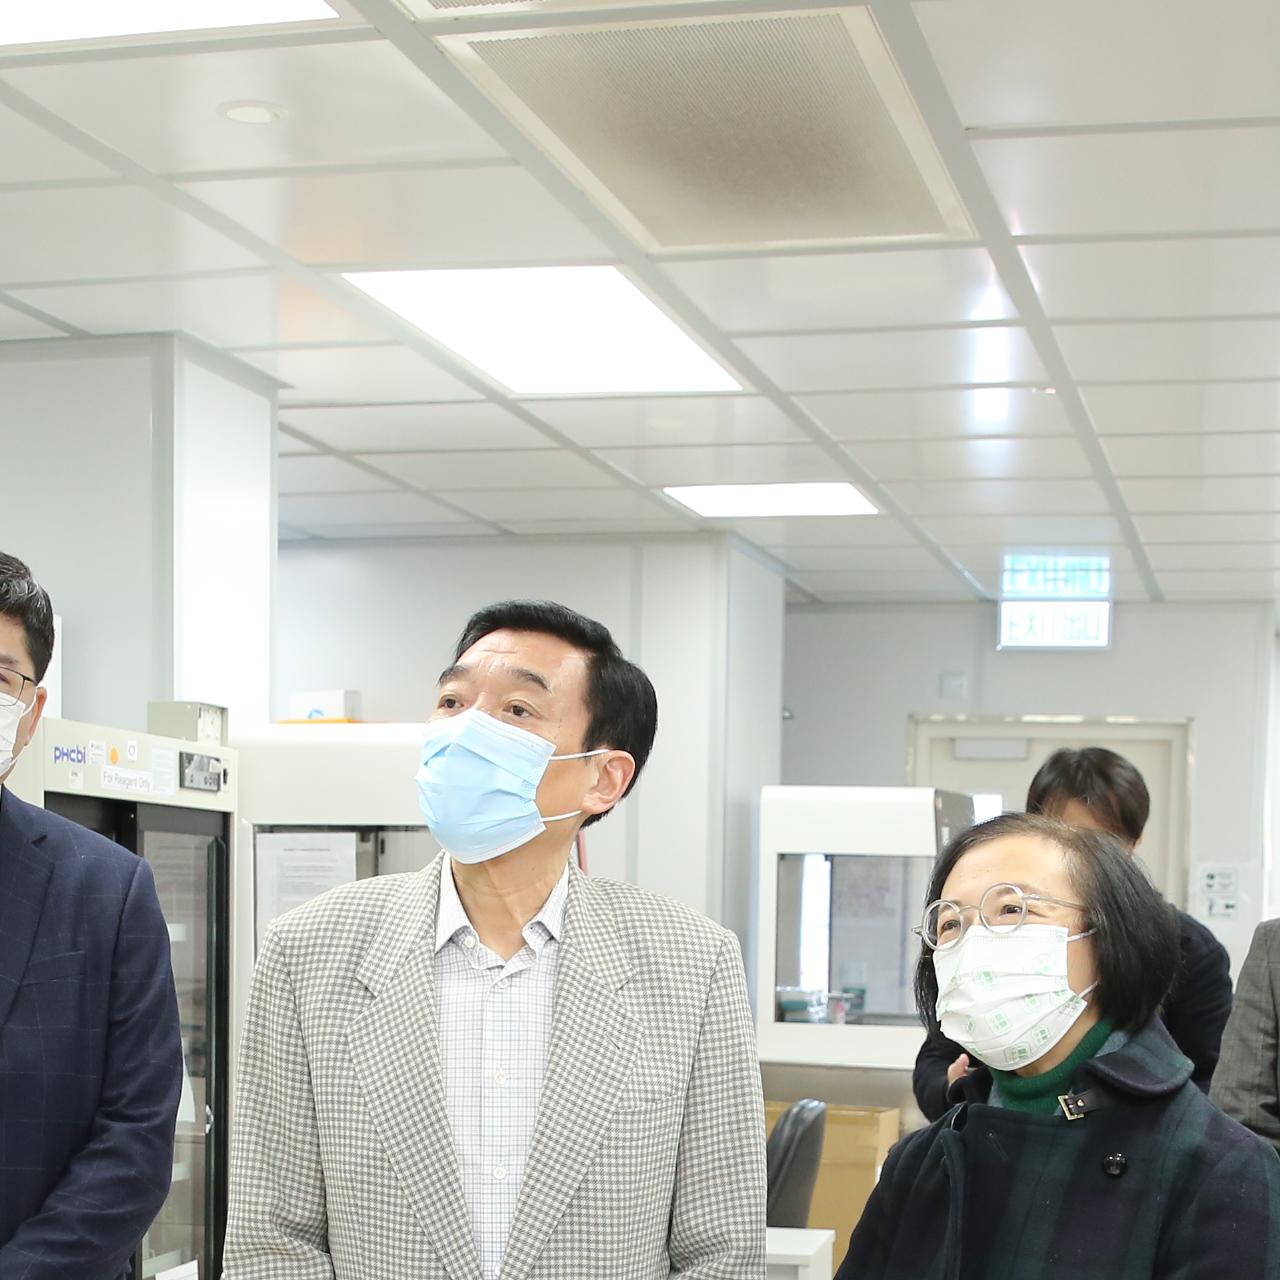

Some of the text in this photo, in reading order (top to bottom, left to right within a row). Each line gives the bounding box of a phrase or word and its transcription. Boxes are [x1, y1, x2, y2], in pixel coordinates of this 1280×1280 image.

[1008, 606, 1101, 642] EXIT 出口
[103, 771, 151, 793] For Reagent Only
